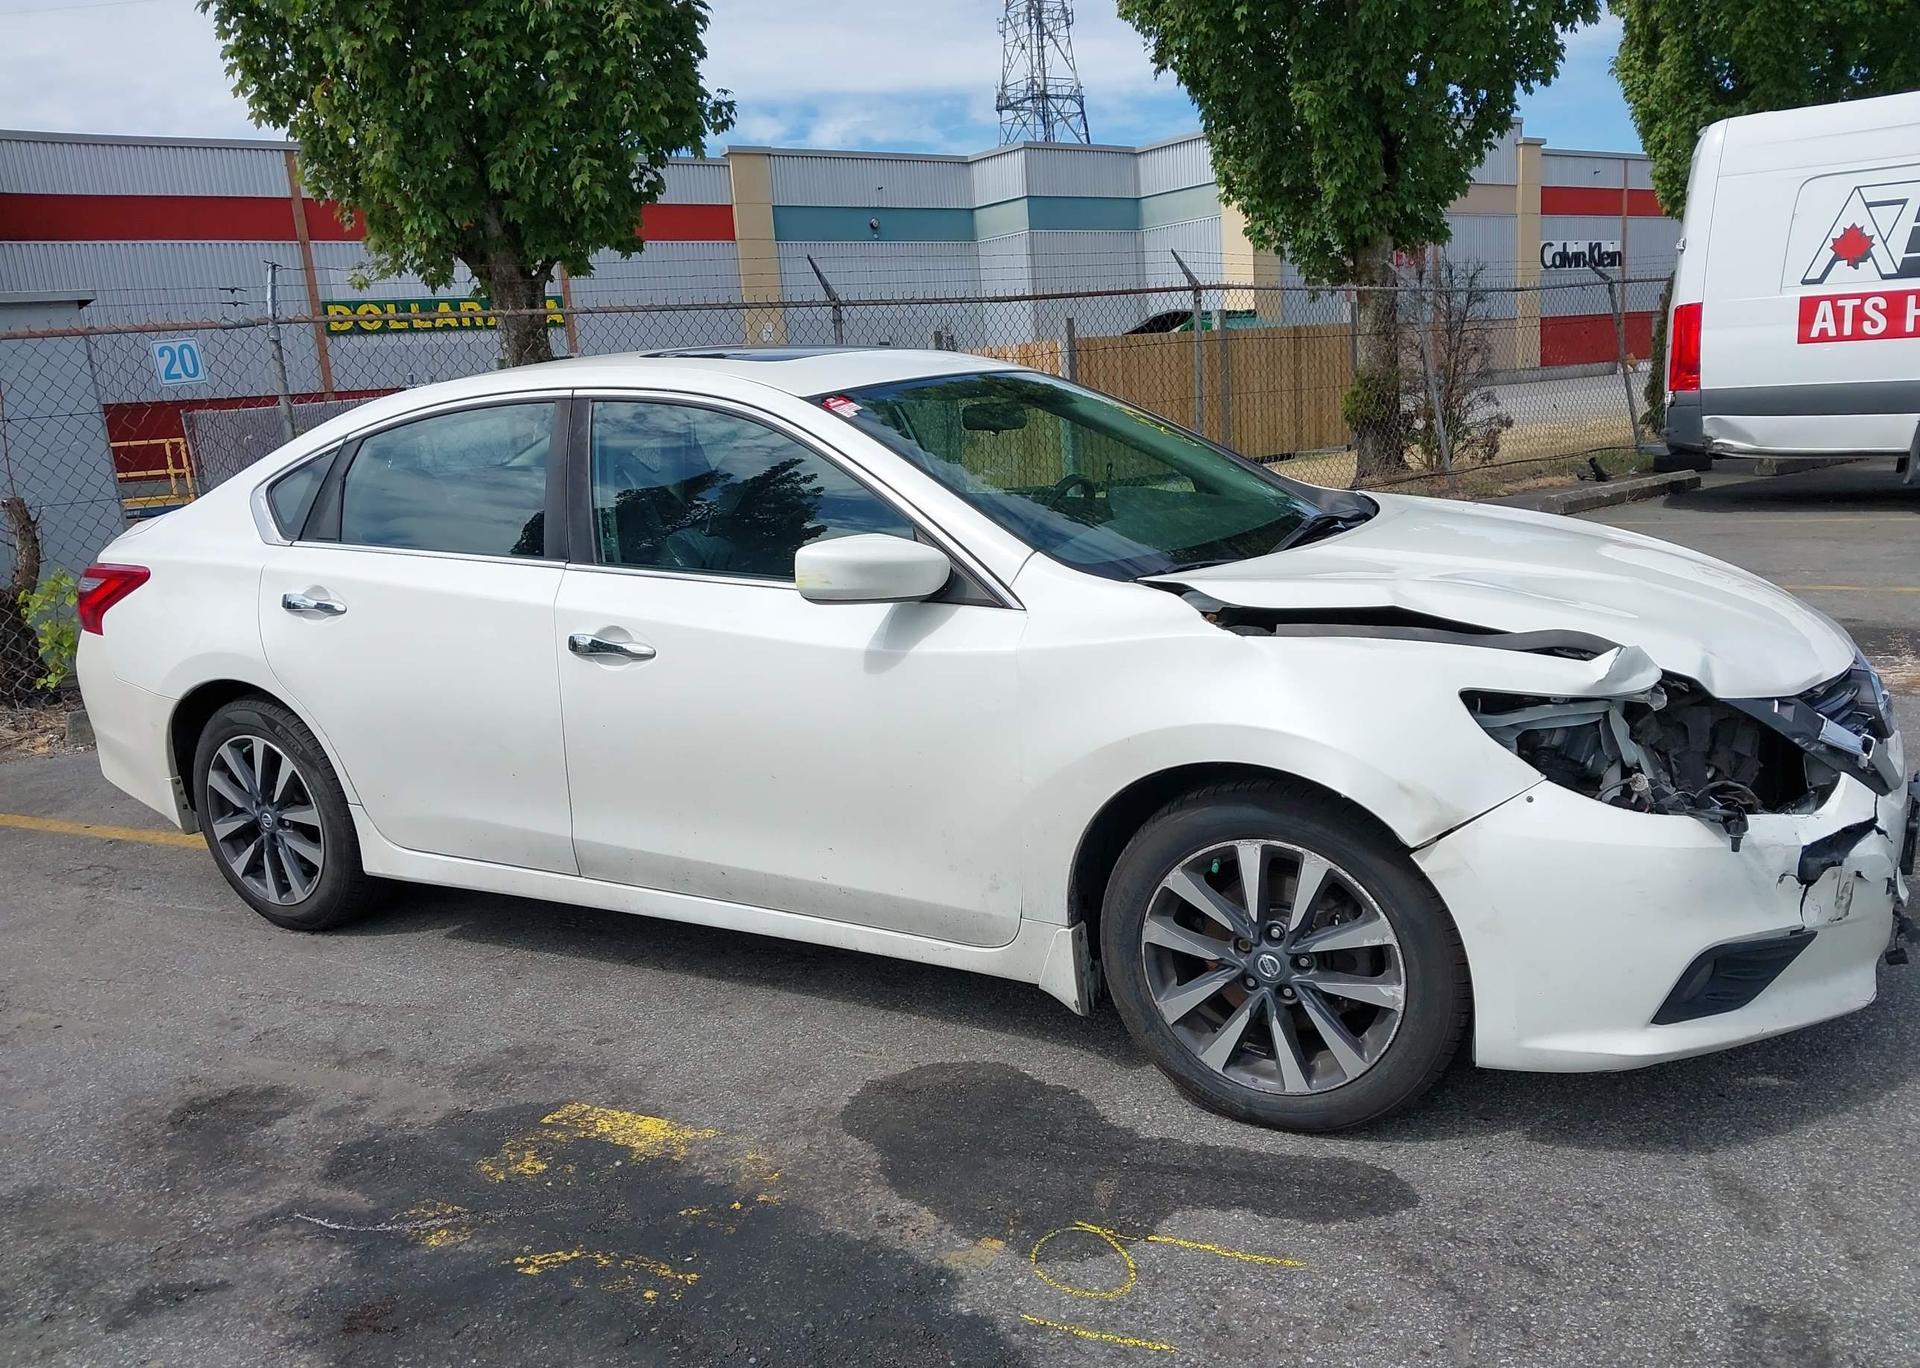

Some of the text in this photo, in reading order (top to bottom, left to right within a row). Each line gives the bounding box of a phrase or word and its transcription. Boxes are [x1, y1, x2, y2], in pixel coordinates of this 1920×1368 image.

[1540, 242, 1622, 269] Calvin Klein
[327, 300, 565, 331] DOLLARA
[1810, 297, 1888, 338] ATS
[158, 344, 199, 379] 20
